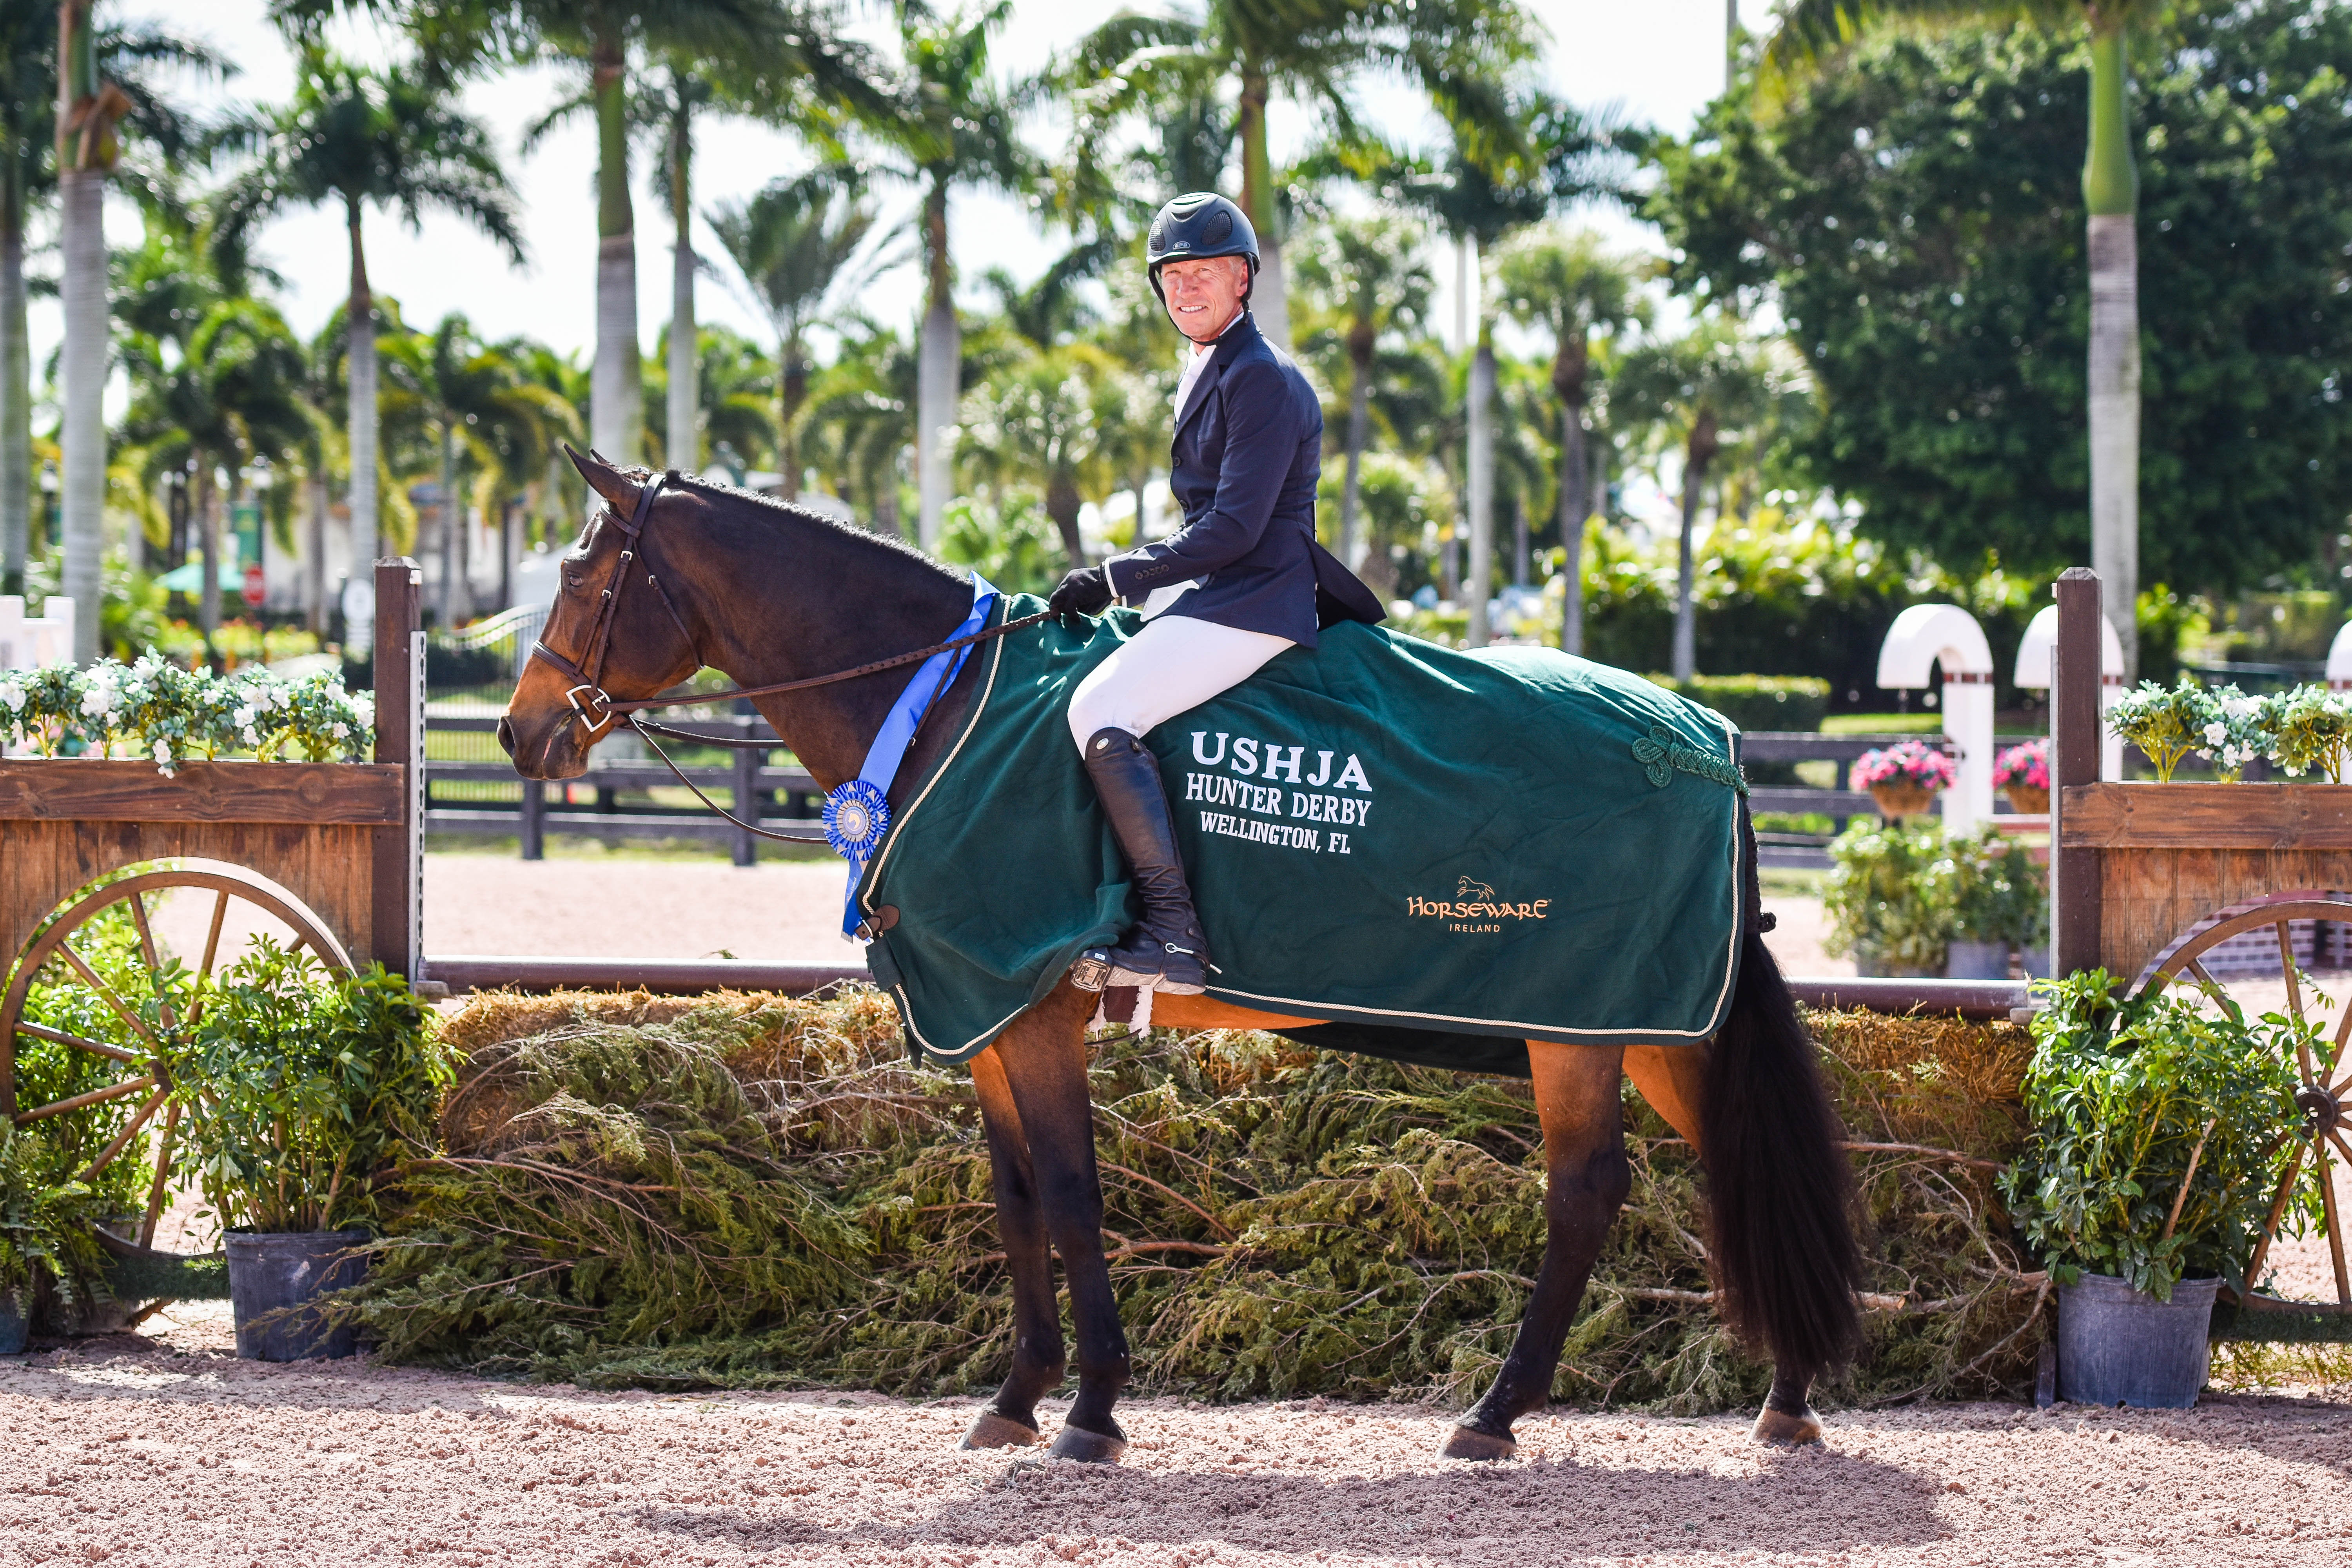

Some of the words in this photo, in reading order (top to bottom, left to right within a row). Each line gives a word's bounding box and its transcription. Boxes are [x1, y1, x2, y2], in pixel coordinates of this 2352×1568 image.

[1191, 731, 1372, 792] USHJA
[1185, 772, 1282, 815] HUNTER
[1290, 792, 1372, 827] DERBY
[1200, 811, 1321, 854] WELLINGTON,
[1328, 832, 1350, 854] FL
[1450, 923, 1501, 933] IRELAND
